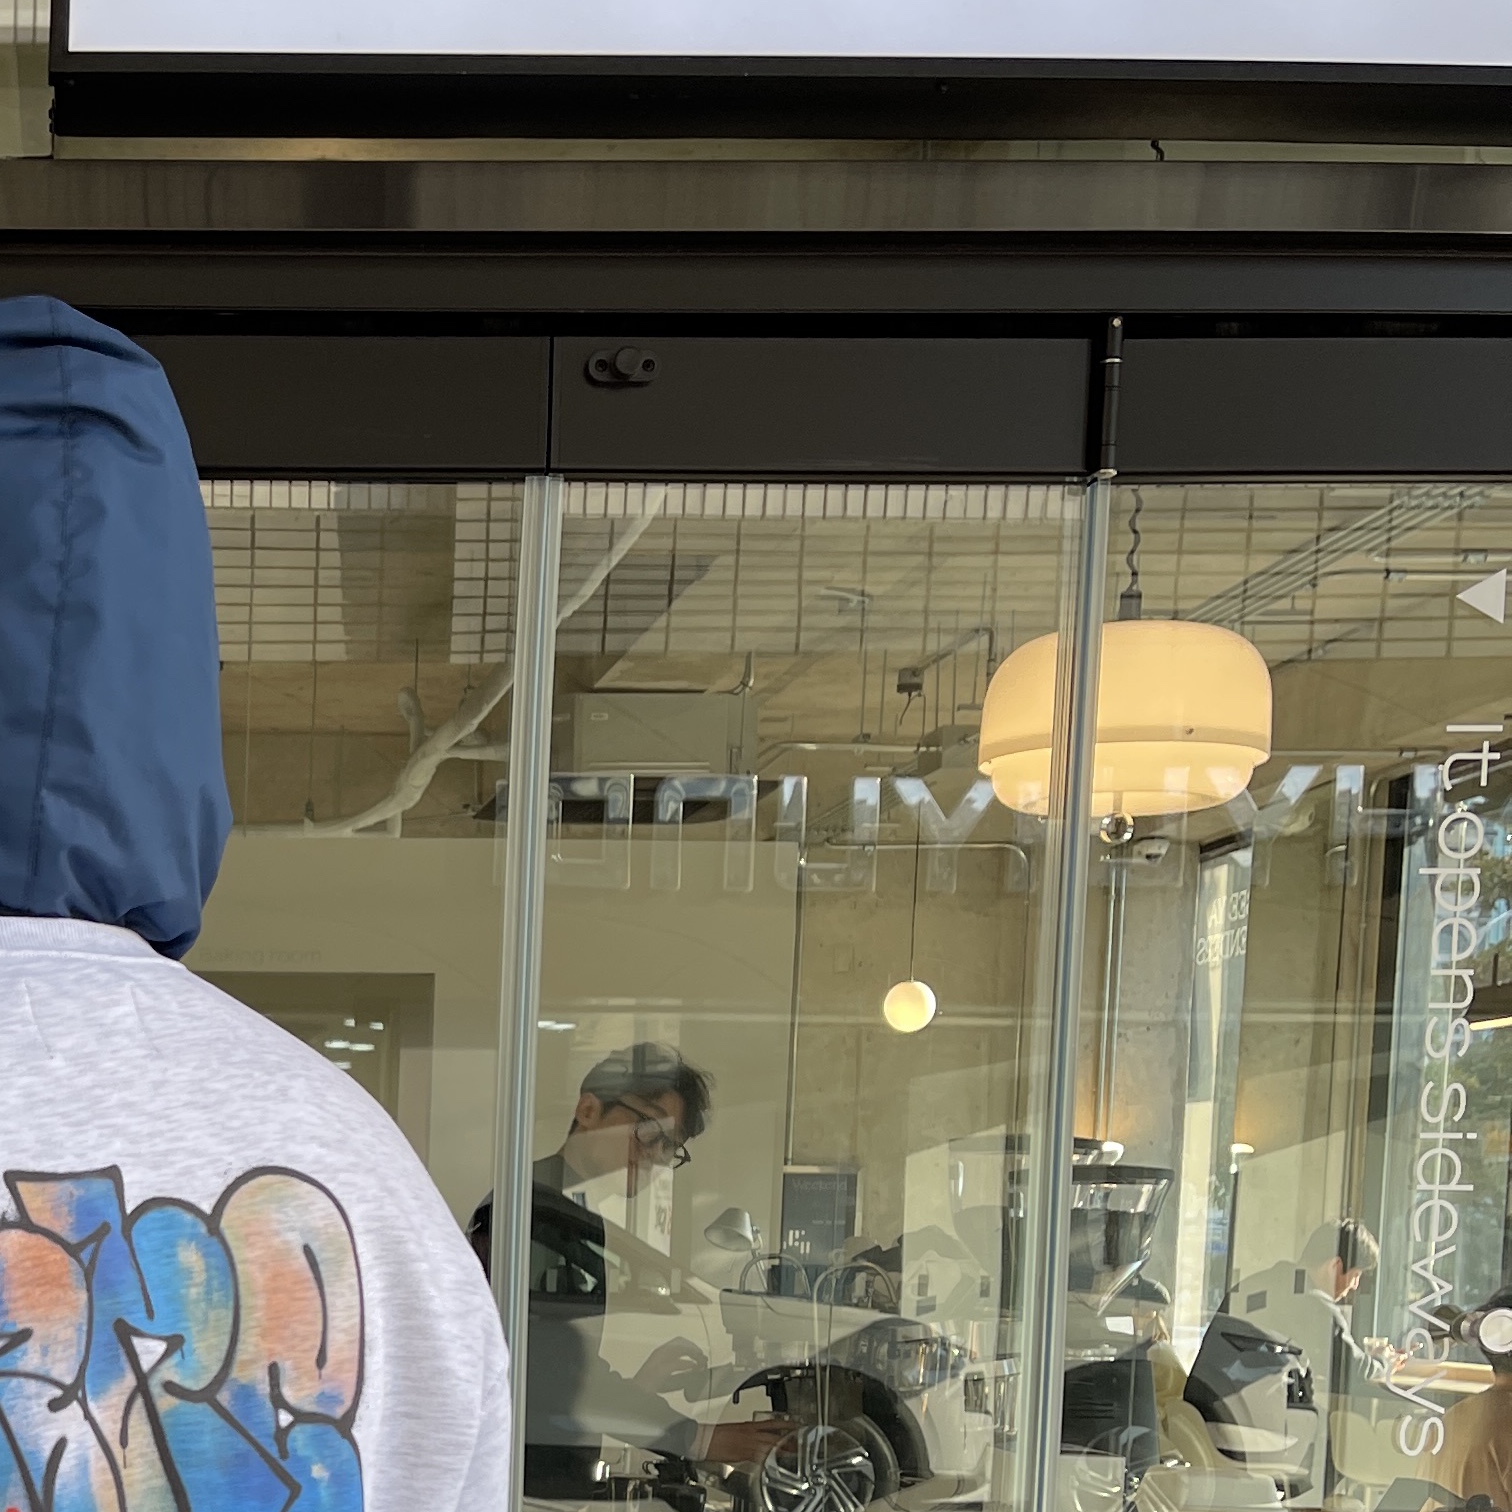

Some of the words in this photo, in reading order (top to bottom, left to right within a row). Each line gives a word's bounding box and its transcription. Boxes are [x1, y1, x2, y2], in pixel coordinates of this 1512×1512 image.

[1442, 723, 1504, 792] It
[269, 949, 322, 964] room
[1418, 810, 1485, 1060] opens
[1386, 1080, 1478, 1457] sideways
